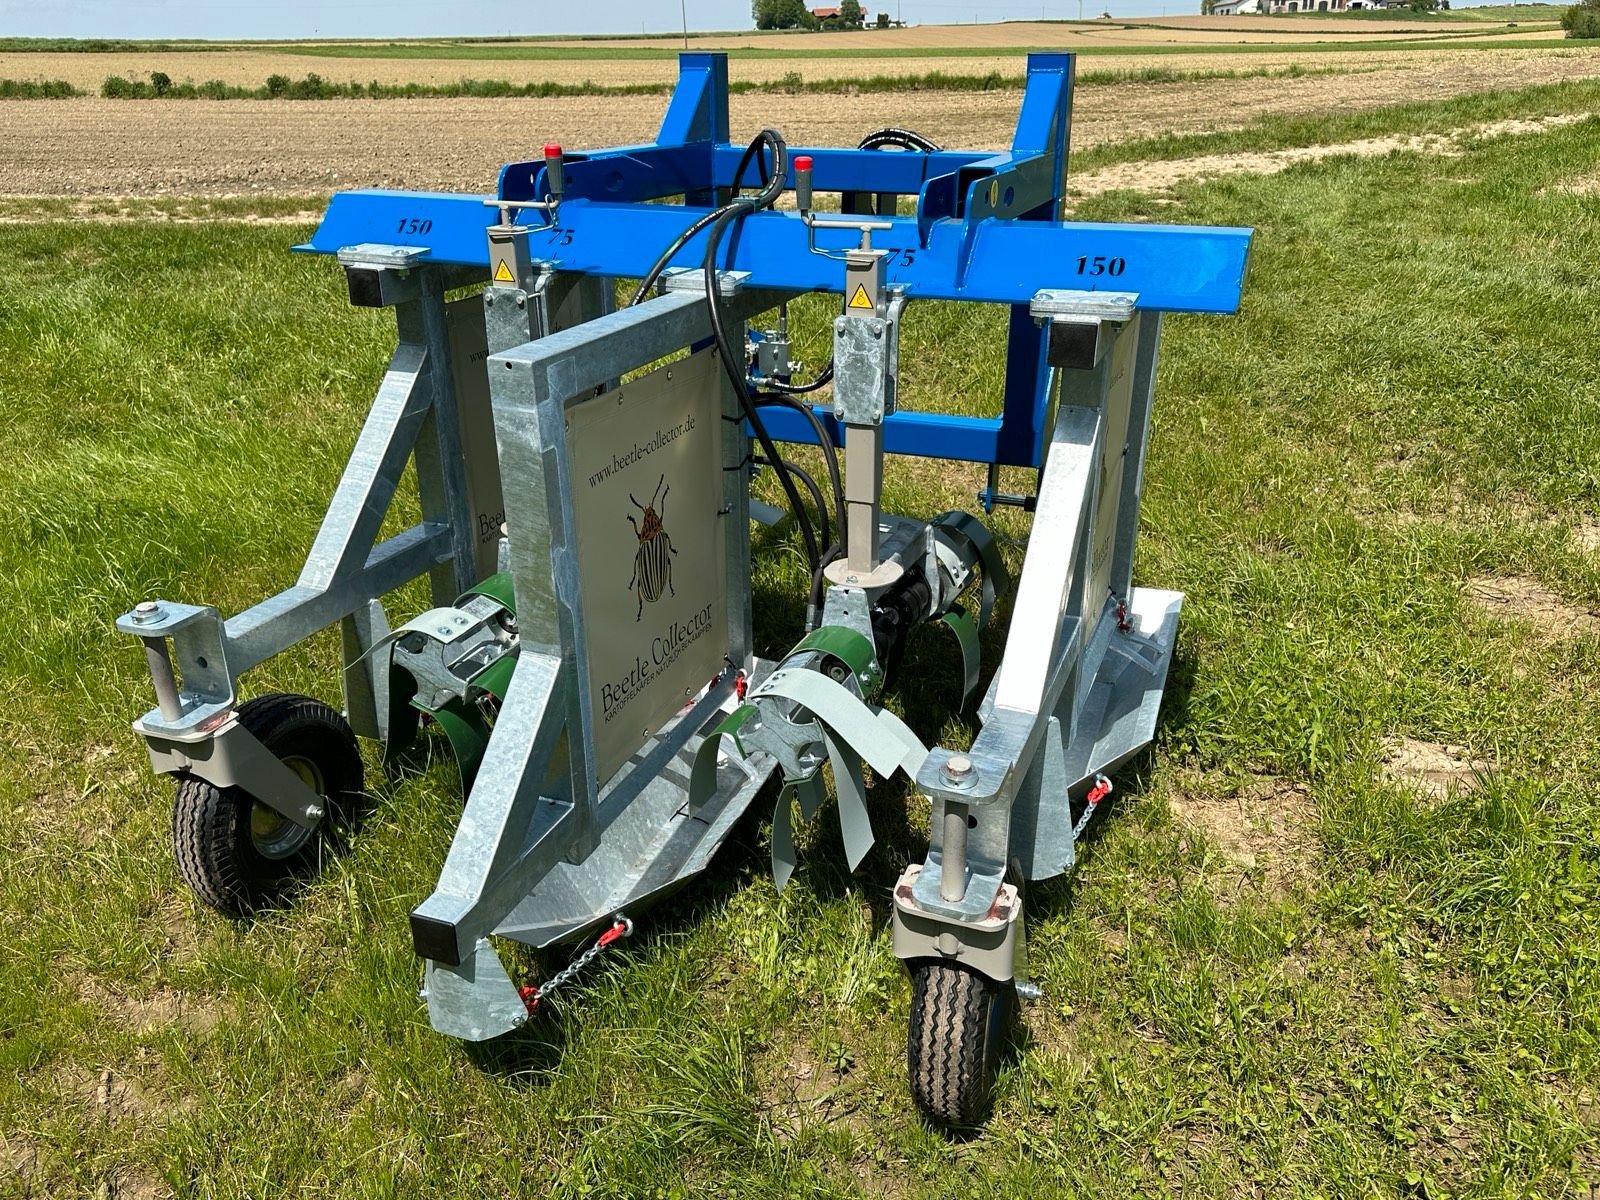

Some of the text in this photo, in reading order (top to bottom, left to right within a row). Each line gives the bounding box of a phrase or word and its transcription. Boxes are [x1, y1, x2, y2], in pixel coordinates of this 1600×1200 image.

[397, 218, 433, 236] 150
[547, 228, 576, 246] 75
[886, 248, 916, 267] 75
[1076, 256, 1126, 277] 150
[588, 414, 695, 488] www.beetle-collector.de
[601, 603, 713, 714] Beetle Collector
